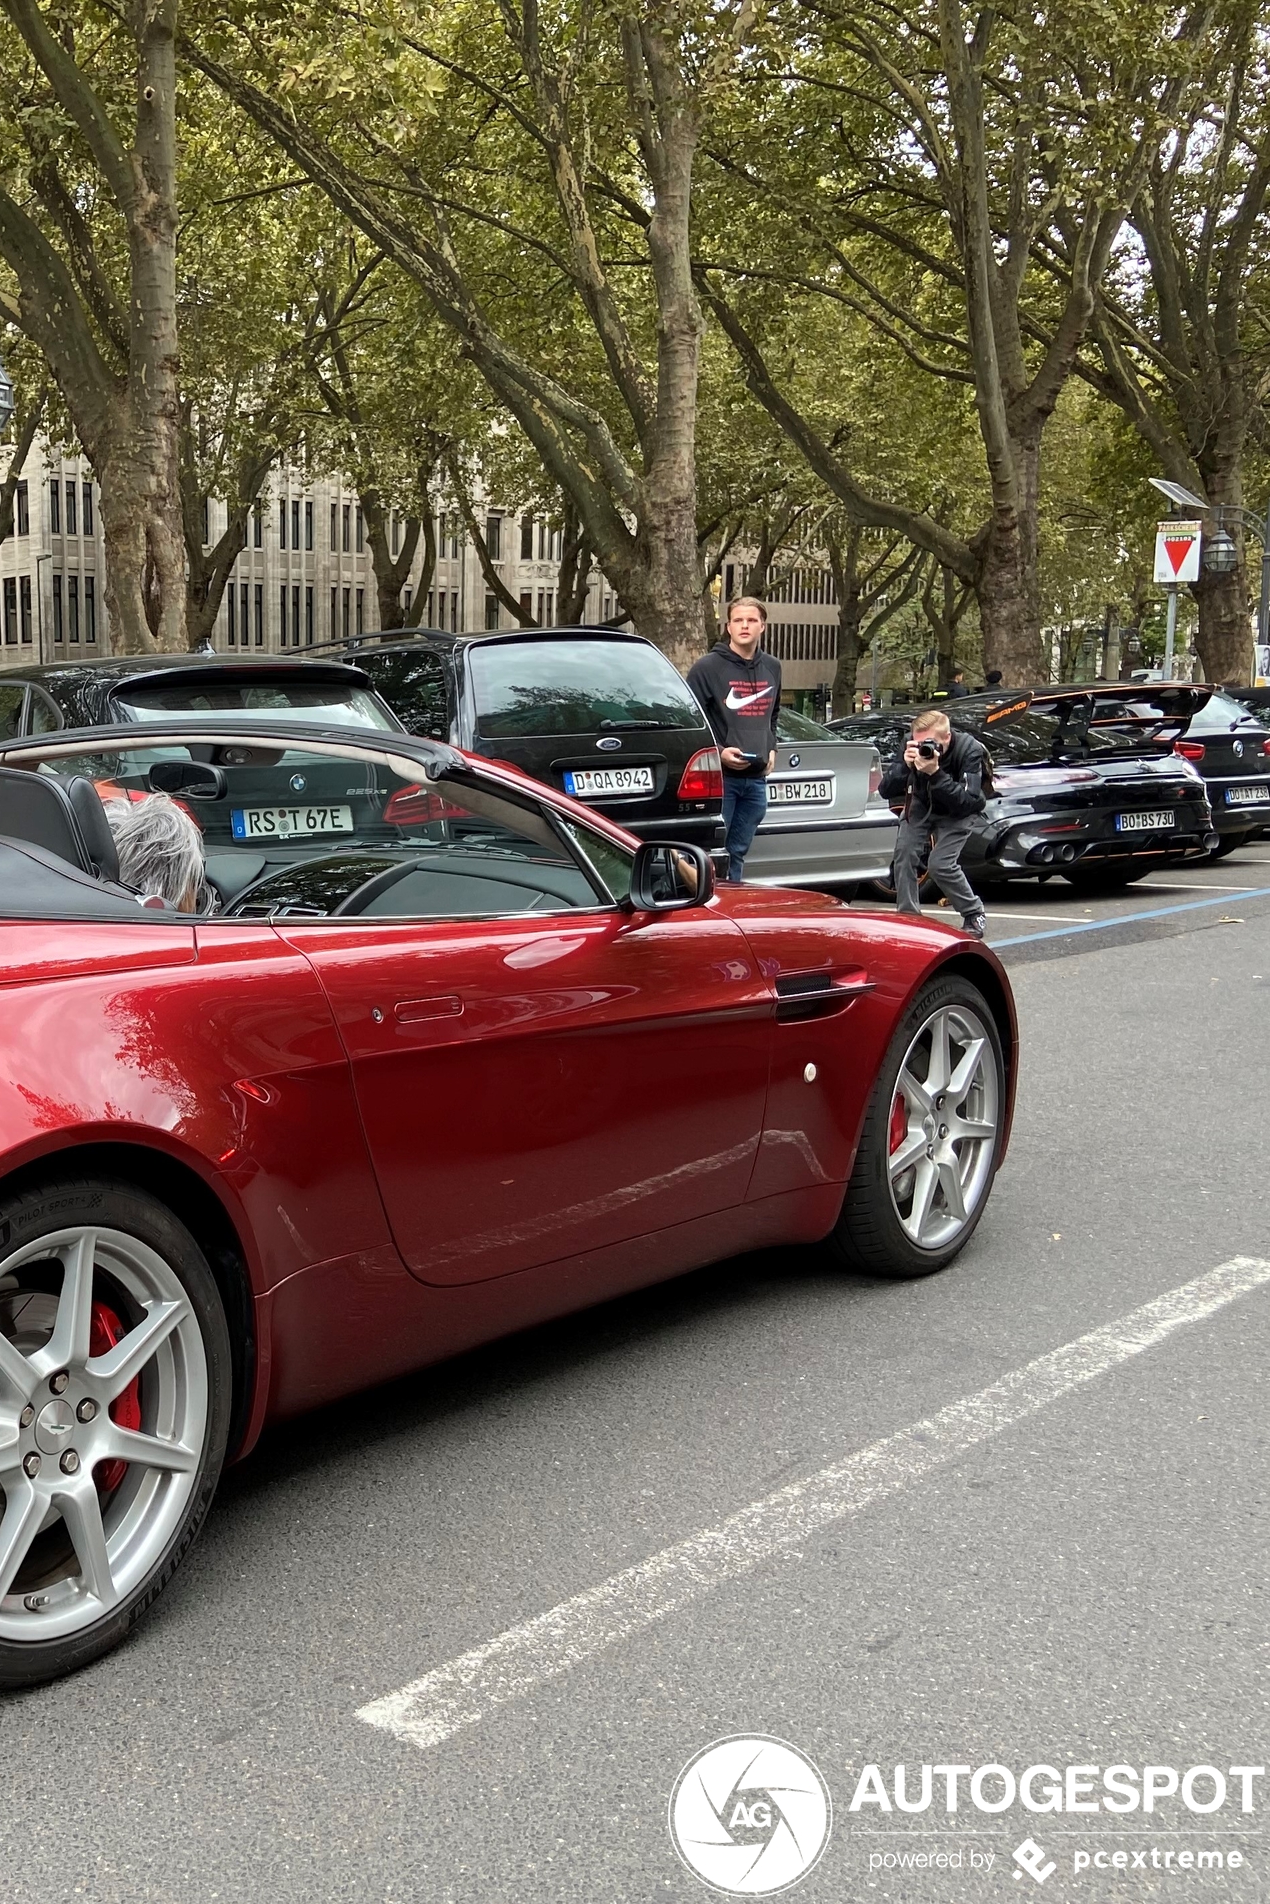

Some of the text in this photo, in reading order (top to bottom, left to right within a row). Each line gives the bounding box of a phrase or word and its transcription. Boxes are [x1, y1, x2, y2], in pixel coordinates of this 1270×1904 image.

[574, 770, 651, 790] D QA 8942
[769, 783, 826, 800] D BW 218
[248, 809, 344, 834] RS T 67E
[1121, 812, 1174, 829] BO BS 730
[18, 1205, 46, 1227] PILOT
[48, 1196, 80, 1213] SPORT
